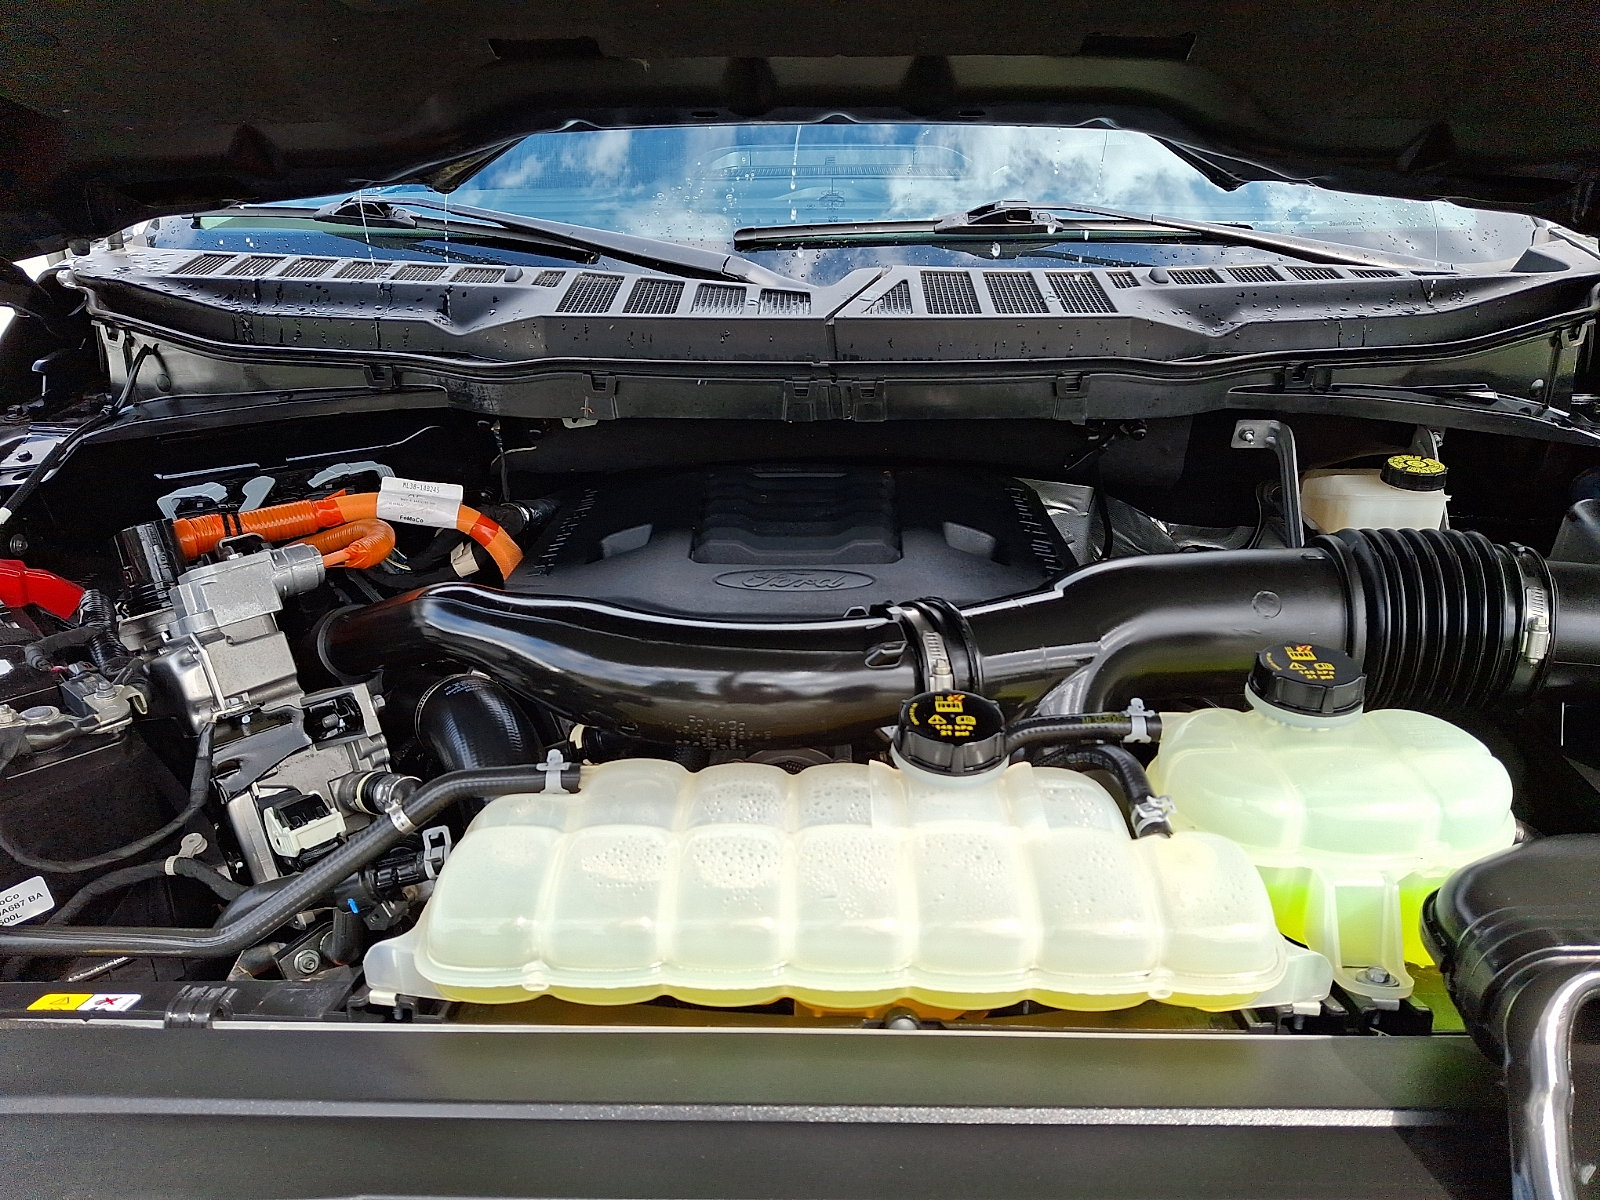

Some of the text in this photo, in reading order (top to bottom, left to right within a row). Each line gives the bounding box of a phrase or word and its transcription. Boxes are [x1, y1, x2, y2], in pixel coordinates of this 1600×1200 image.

[742, 572, 847, 589] Ford
[0, 892, 44, 916] A687 BA
